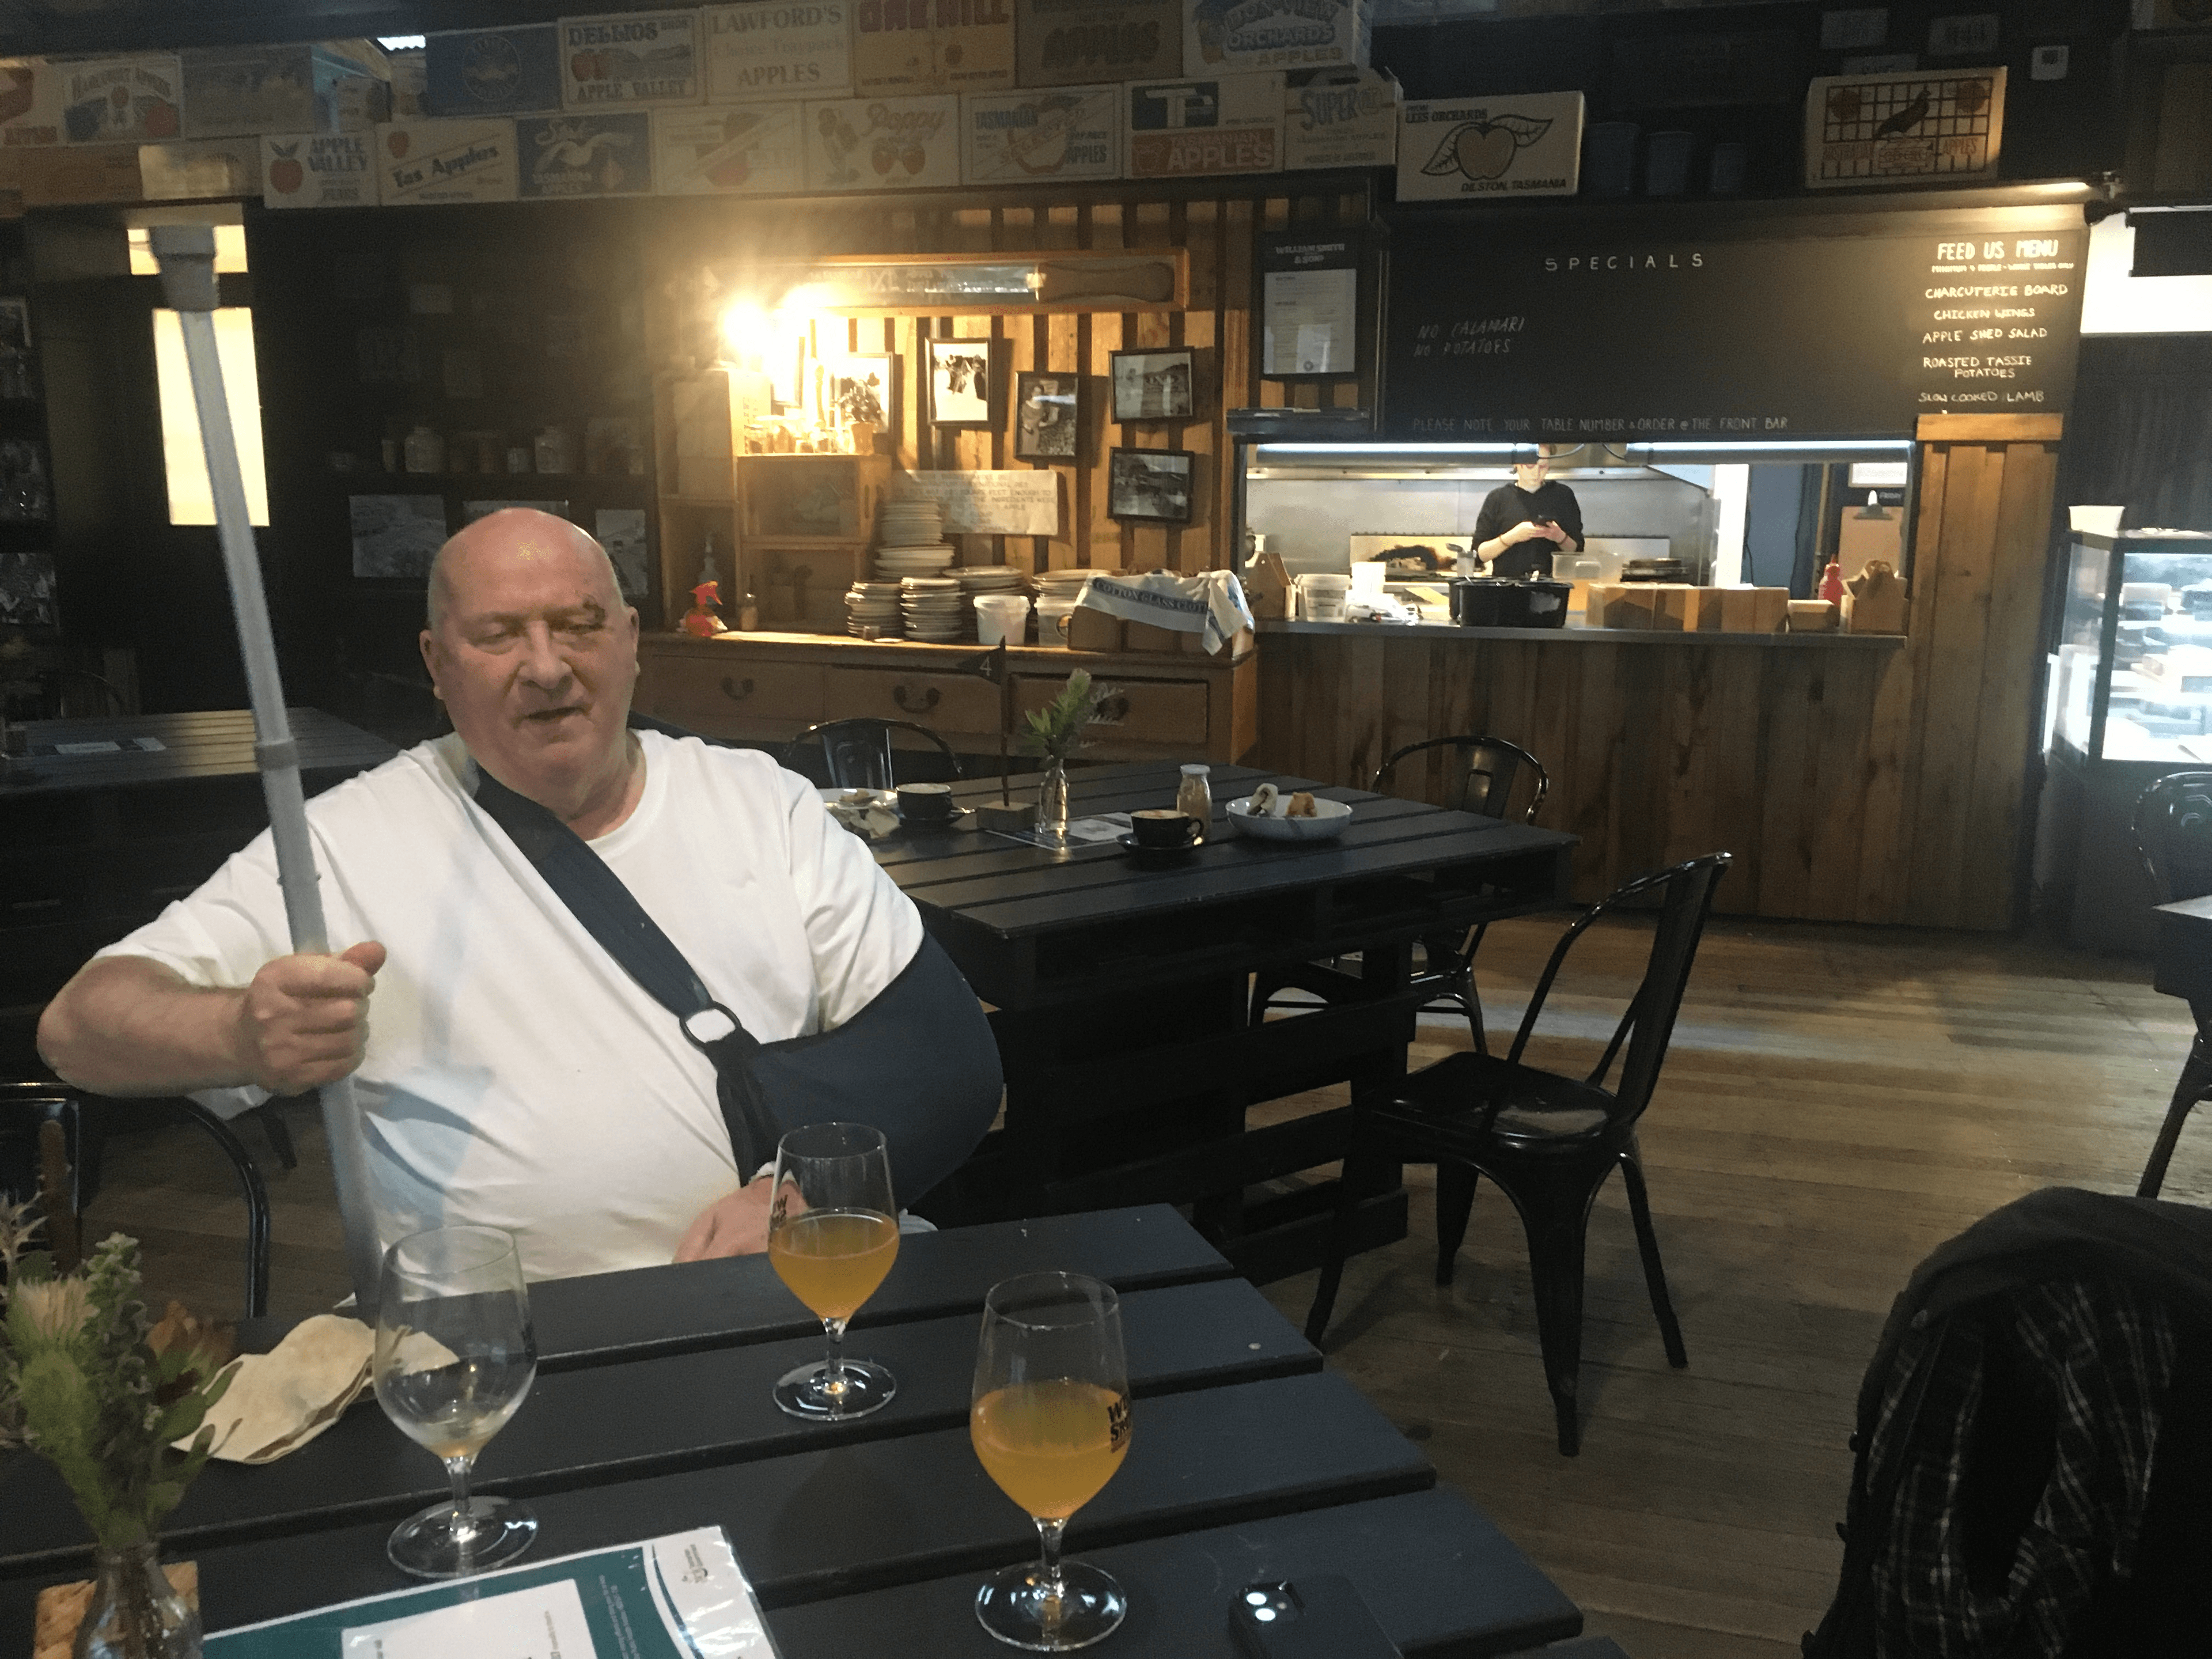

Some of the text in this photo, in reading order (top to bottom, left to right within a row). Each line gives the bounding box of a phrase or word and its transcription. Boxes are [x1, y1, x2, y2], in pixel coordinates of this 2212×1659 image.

[713, 4, 842, 34] LAWFORD'S
[1227, 23, 1336, 52] ORCHARDS
[1256, 46, 1343, 66] APPLES
[737, 62, 820, 86] APPLES
[577, 79, 687, 103] APPLE VALLEY
[1432, 108, 1488, 122] ORCHARDS
[310, 137, 363, 154] APPLE
[1066, 144, 1107, 164] APPLES
[1942, 138, 1978, 156] APPLES
[307, 154, 367, 172] VALLEY
[431, 145, 501, 177] Apples
[1167, 142, 1273, 171] APPLES
[1512, 178, 1566, 191] TASMANIA
[1937, 239, 2059, 260] FEED US MENU
[1544, 253, 1704, 271] SPECIALS
[1925, 284, 2069, 299] CHARCUTERIE BOARD
[1933, 308, 2035, 320] CHICKEN WINGS
[1417, 316, 1525, 339] NO CALAMARI
[1922, 327, 2048, 344] APPLE SHED SALAD
[1923, 355, 2032, 369] ROASTED TASSIE
[1954, 368, 2016, 378] POTATOES
[1918, 389, 2045, 403] SLOW COOKED LAMB
[1412, 417, 1455, 432] PLEASE
[1463, 417, 1493, 432] NOTE
[1503, 417, 1531, 431] YOUR
[1540, 417, 1574, 431] TABLE
[1578, 417, 1626, 431] NUMBER
[1637, 418, 1676, 430] ORDER
[1692, 417, 1711, 430] THE
[1719, 416, 1758, 430] FRONT
[1764, 416, 1789, 430] BAR
[1096, 581, 1139, 601] COTTON
[1141, 591, 1175, 609] GLASS
[979, 655, 993, 676] 4
